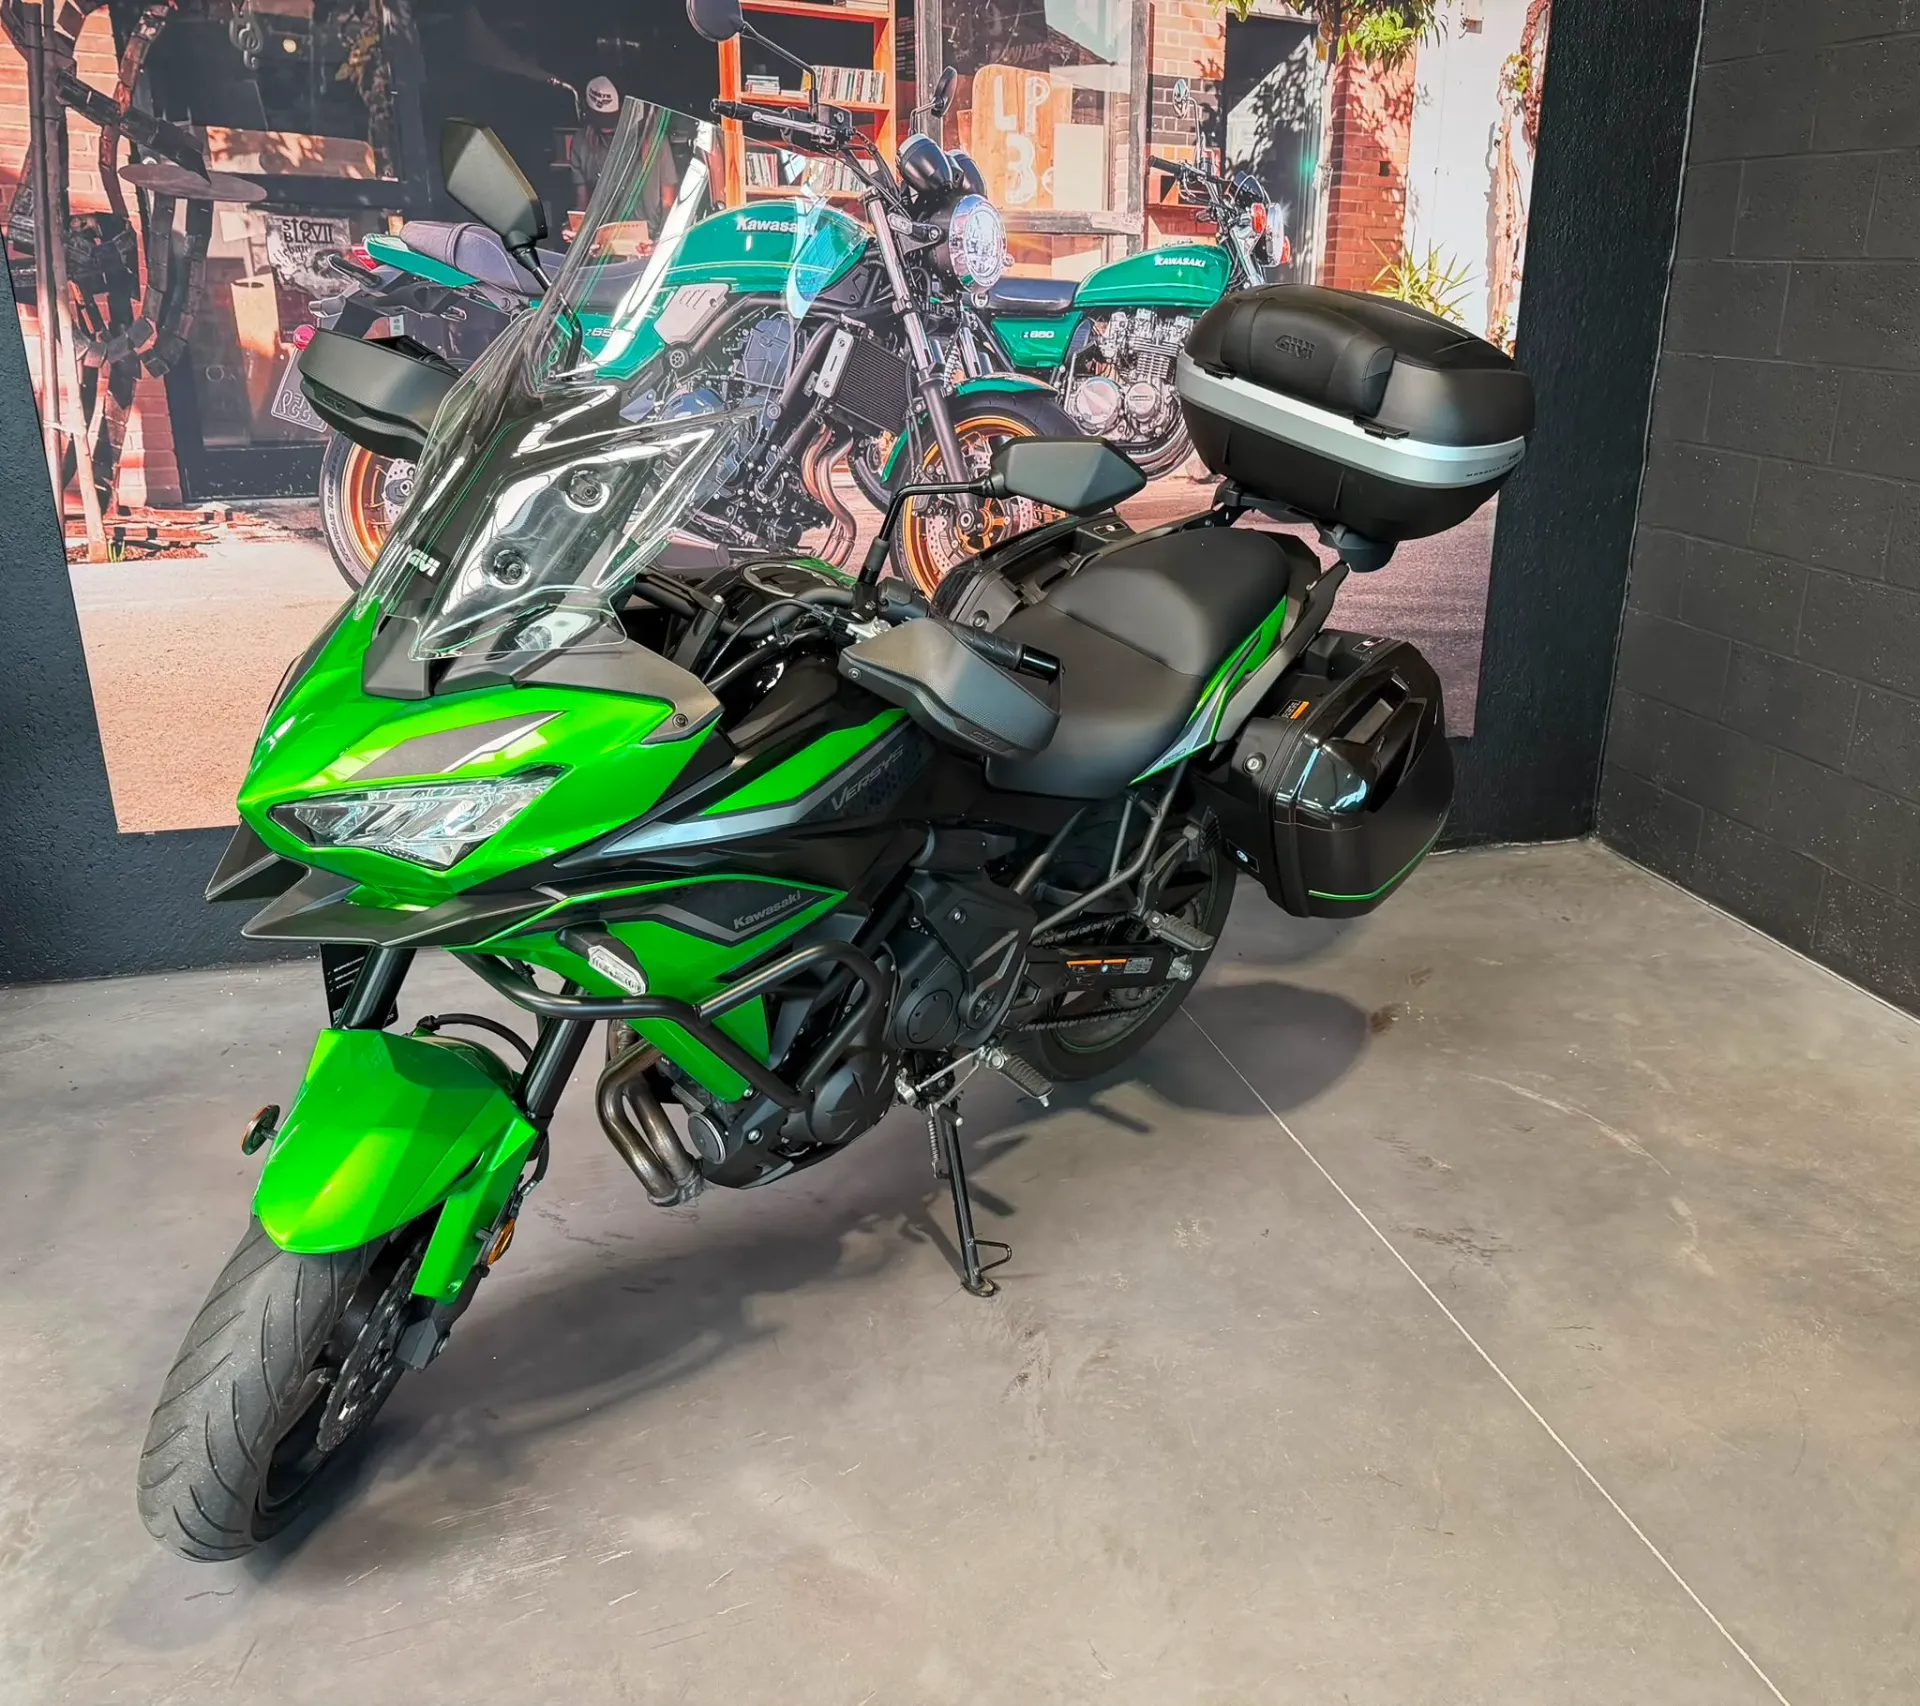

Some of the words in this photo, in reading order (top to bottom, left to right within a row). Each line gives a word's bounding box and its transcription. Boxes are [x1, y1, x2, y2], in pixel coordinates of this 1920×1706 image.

[994, 75, 1050, 134] LP
[1154, 254, 1206, 268] KAWASAKI
[408, 548, 440, 577] GIVI
[831, 745, 904, 811] VERSYS
[733, 889, 801, 930] Kawasaki
